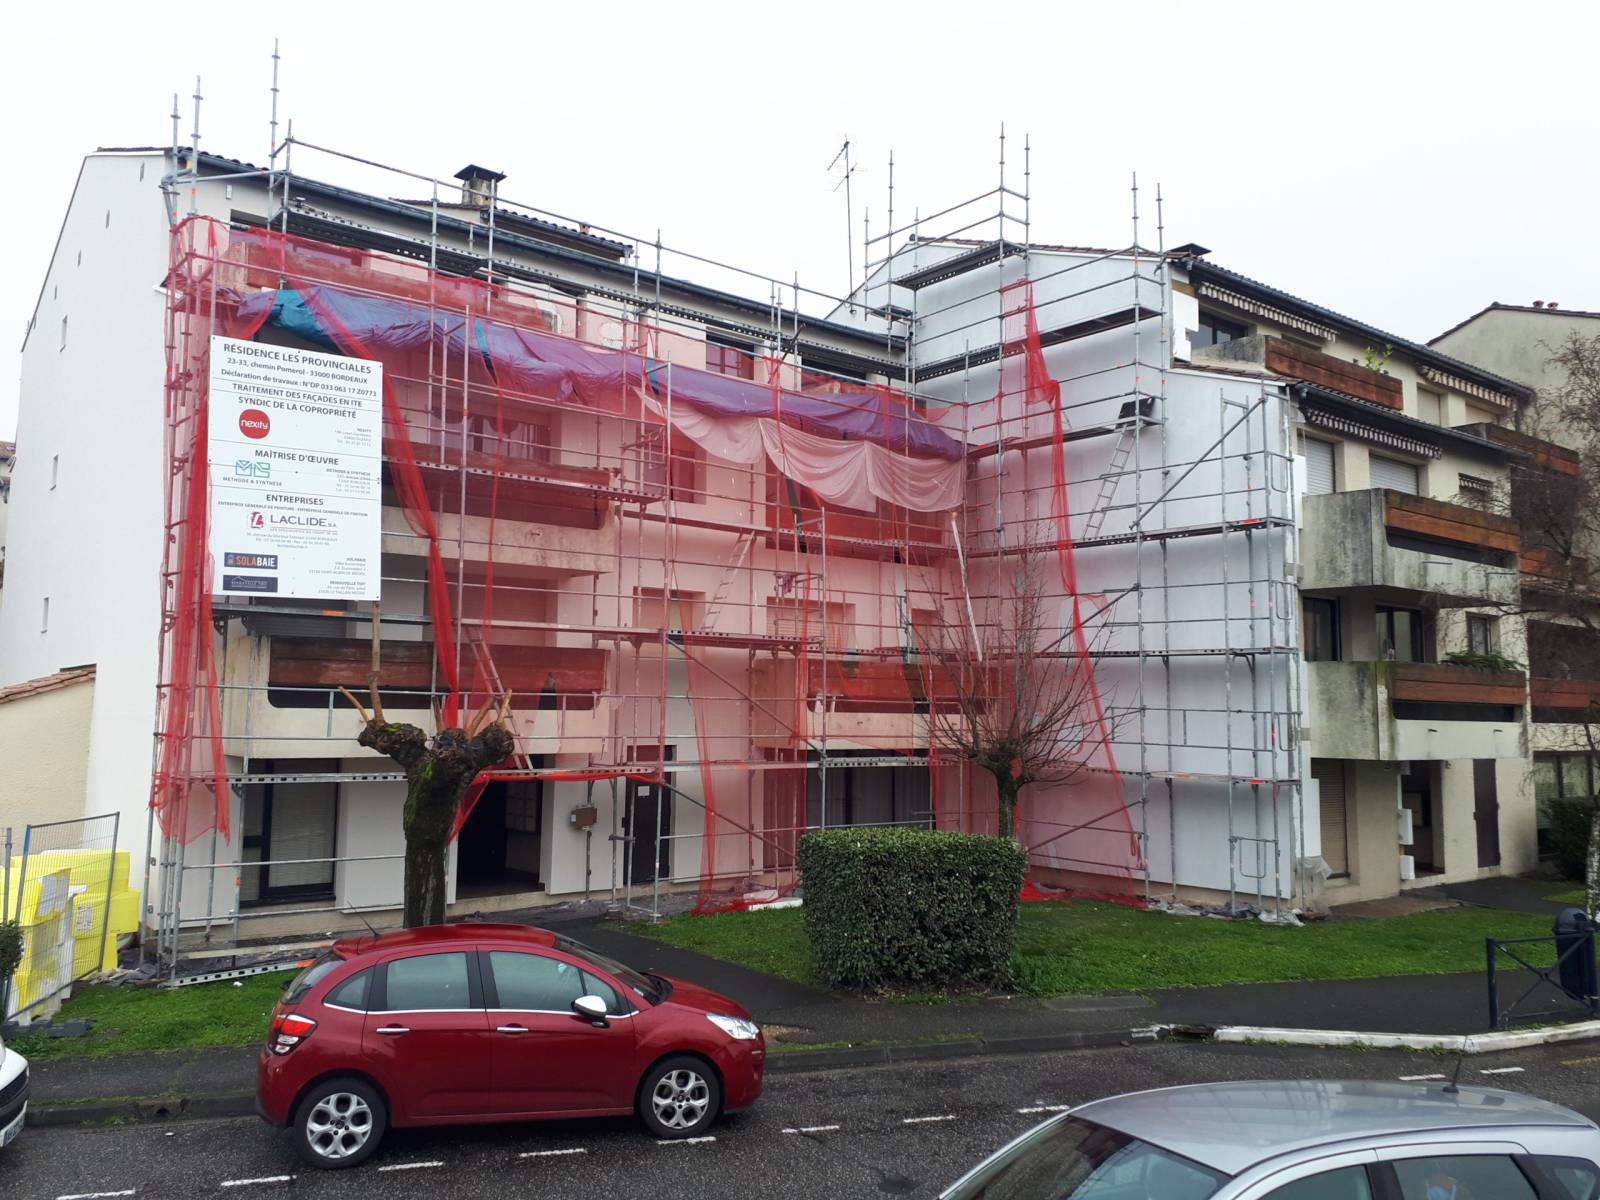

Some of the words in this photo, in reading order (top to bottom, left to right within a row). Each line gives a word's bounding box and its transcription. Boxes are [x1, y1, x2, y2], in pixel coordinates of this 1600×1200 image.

[224, 343, 280, 360] RÉSIDENCE
[282, 353, 300, 363] LES
[302, 356, 372, 374] PROVINCIALES
[221, 368, 262, 380] Déclaration
[272, 377, 298, 386] travaux
[320, 383, 333, 391] 033
[227, 357, 249, 367] 23-33,
[250, 361, 276, 371] chemin
[277, 365, 305, 375] Pomerol
[310, 370, 330, 379] 33000
[331, 373, 368, 384] BORDEAUX
[232, 383, 284, 396] TRAITEMENT
[285, 390, 301, 399] DES
[302, 393, 338, 404] FAÇADES
[339, 398, 350, 406] EN
[351, 400, 363, 408] ITE
[238, 396, 271, 408] SYNDIC
[272, 400, 285, 410] DE
[286, 402, 298, 411] LA
[299, 404, 357, 419] COPROPRIÉTÉ
[240, 419, 269, 430] nexity
[255, 449, 296, 461] MAÎTRISE
[298, 454, 339, 466] D'ŒUVRE
[266, 494, 324, 506] ENTREPRISES
[270, 514, 328, 527] LACLIDE
[236, 555, 277, 567] SOLABAIE
